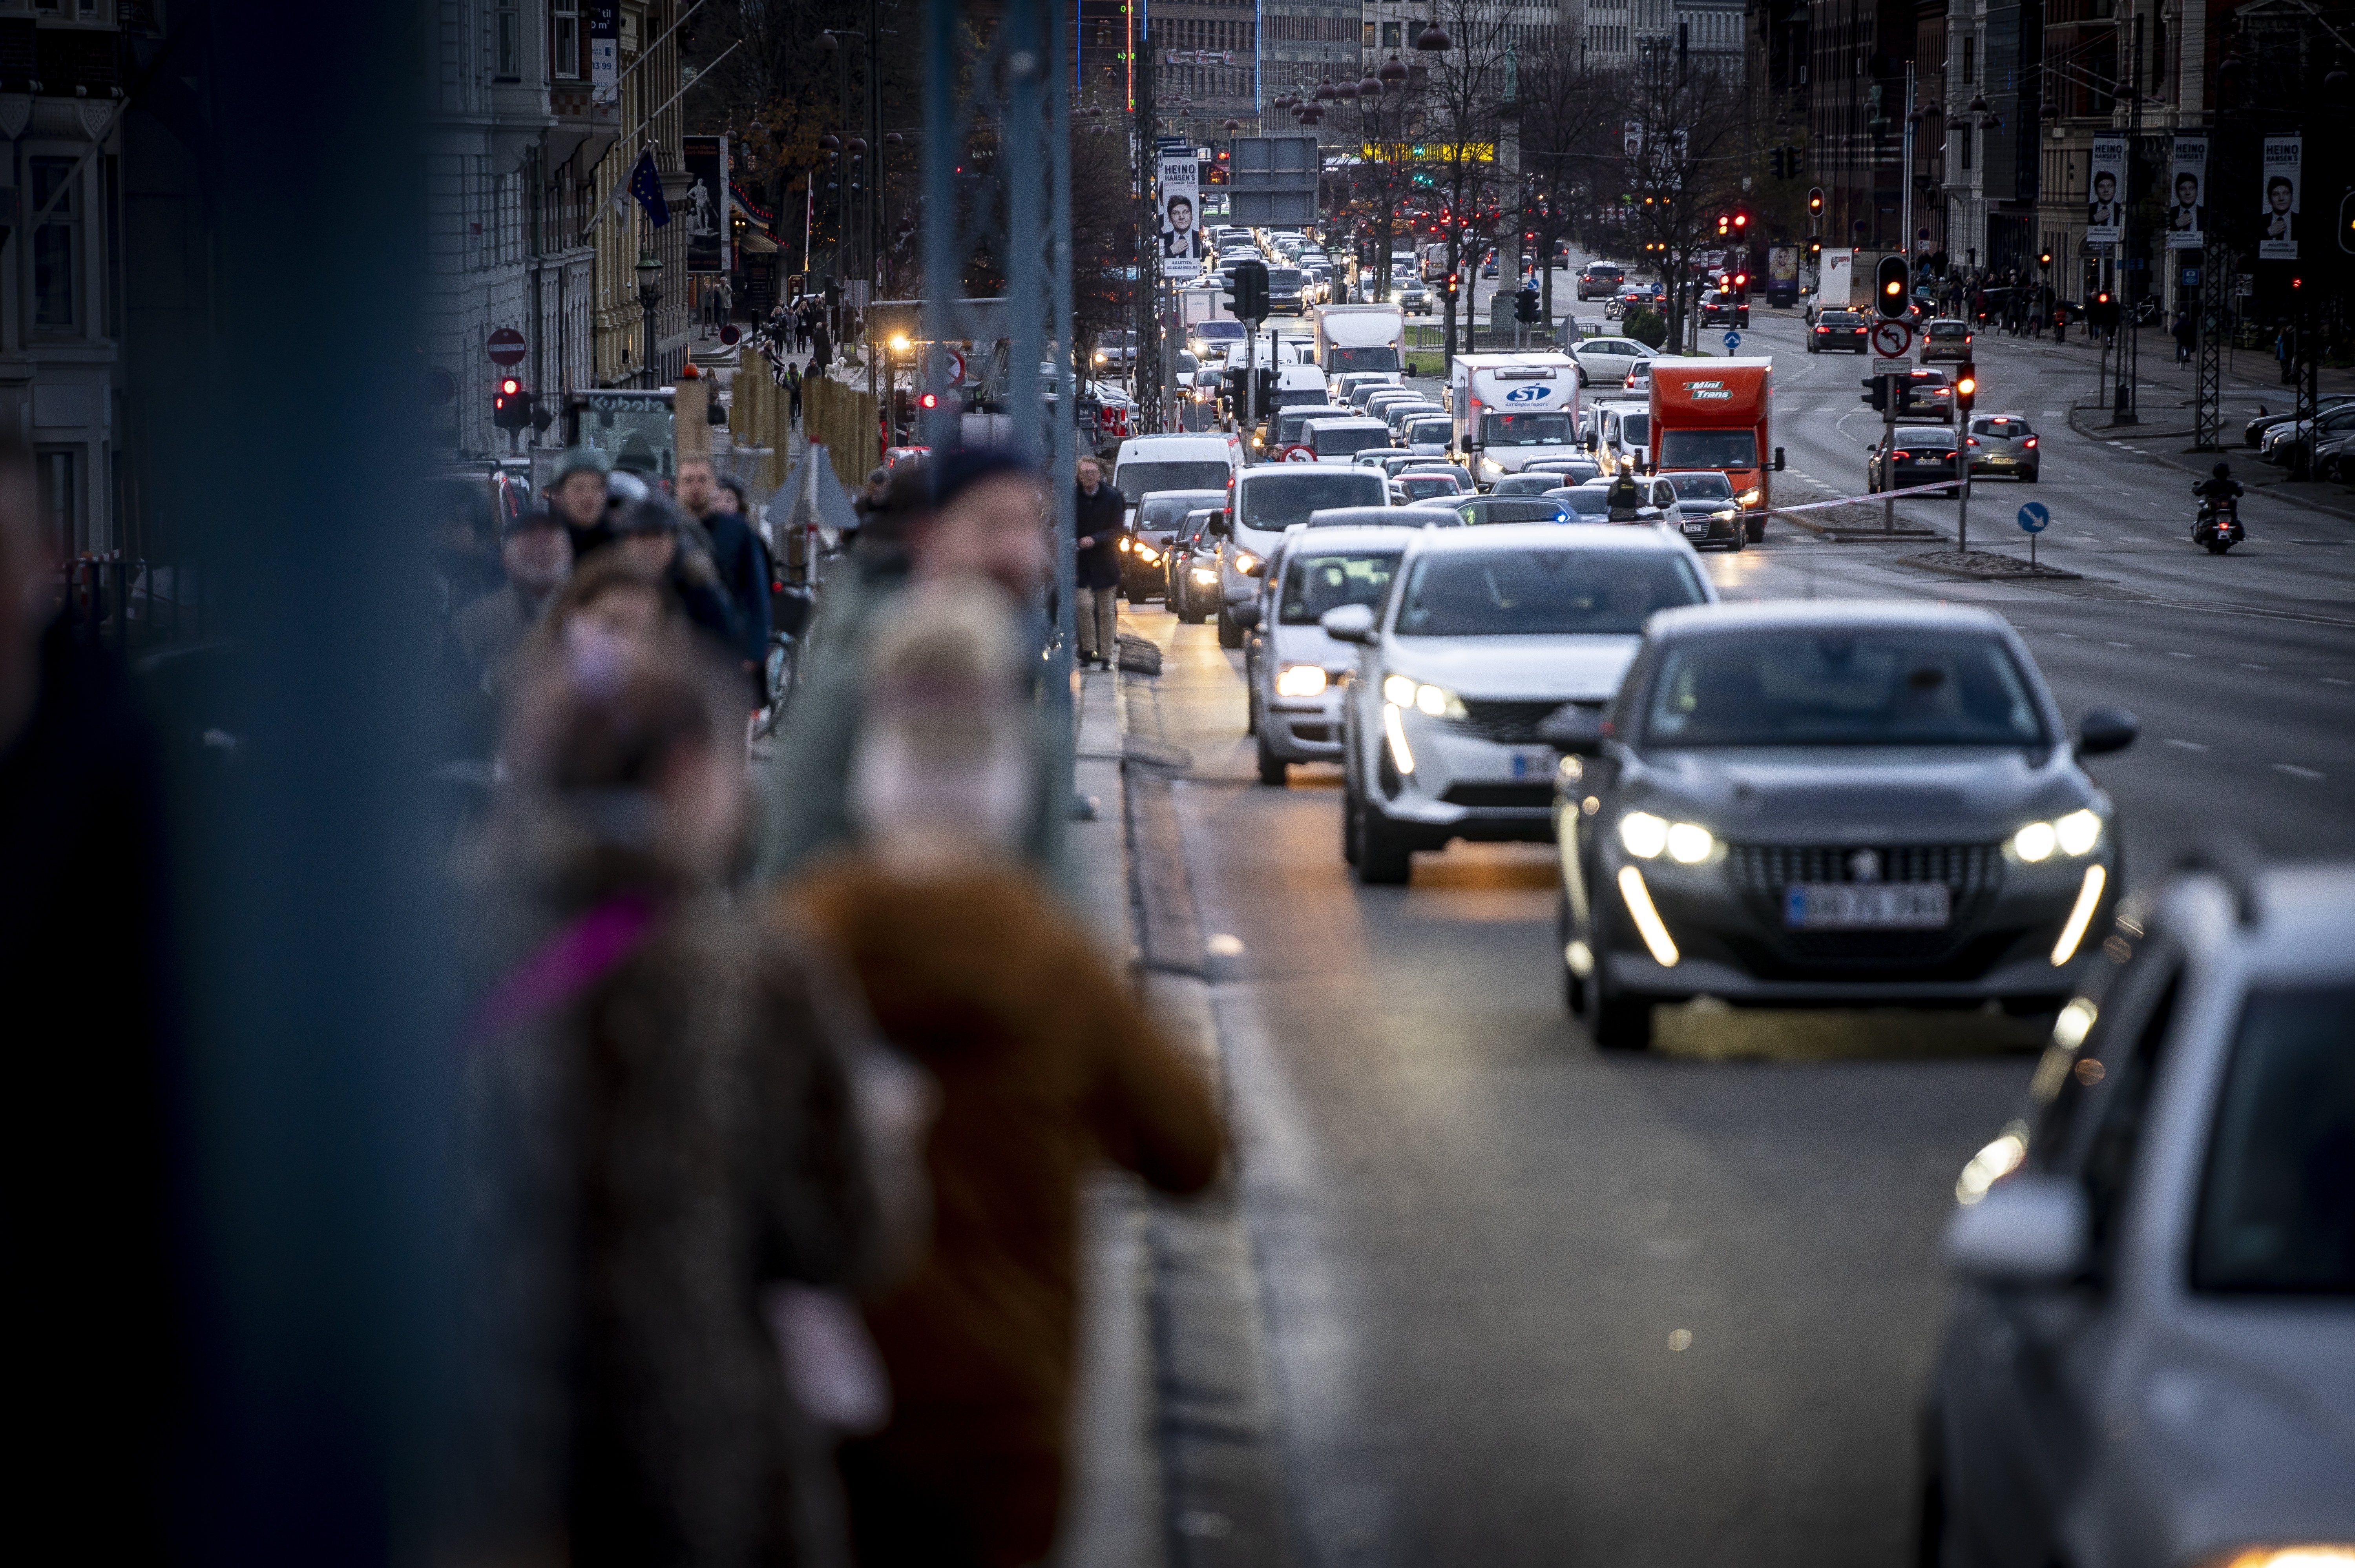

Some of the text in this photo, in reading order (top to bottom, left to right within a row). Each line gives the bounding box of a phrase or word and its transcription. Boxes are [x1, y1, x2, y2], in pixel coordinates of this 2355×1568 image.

[602, 9, 611, 18] til
[2095, 144, 2122, 153] HEINO
[2176, 144, 2205, 153] HEINO
[2267, 144, 2298, 154] HEINO
[1165, 164, 1195, 174] HEINO
[589, 396, 666, 412] Kubota
